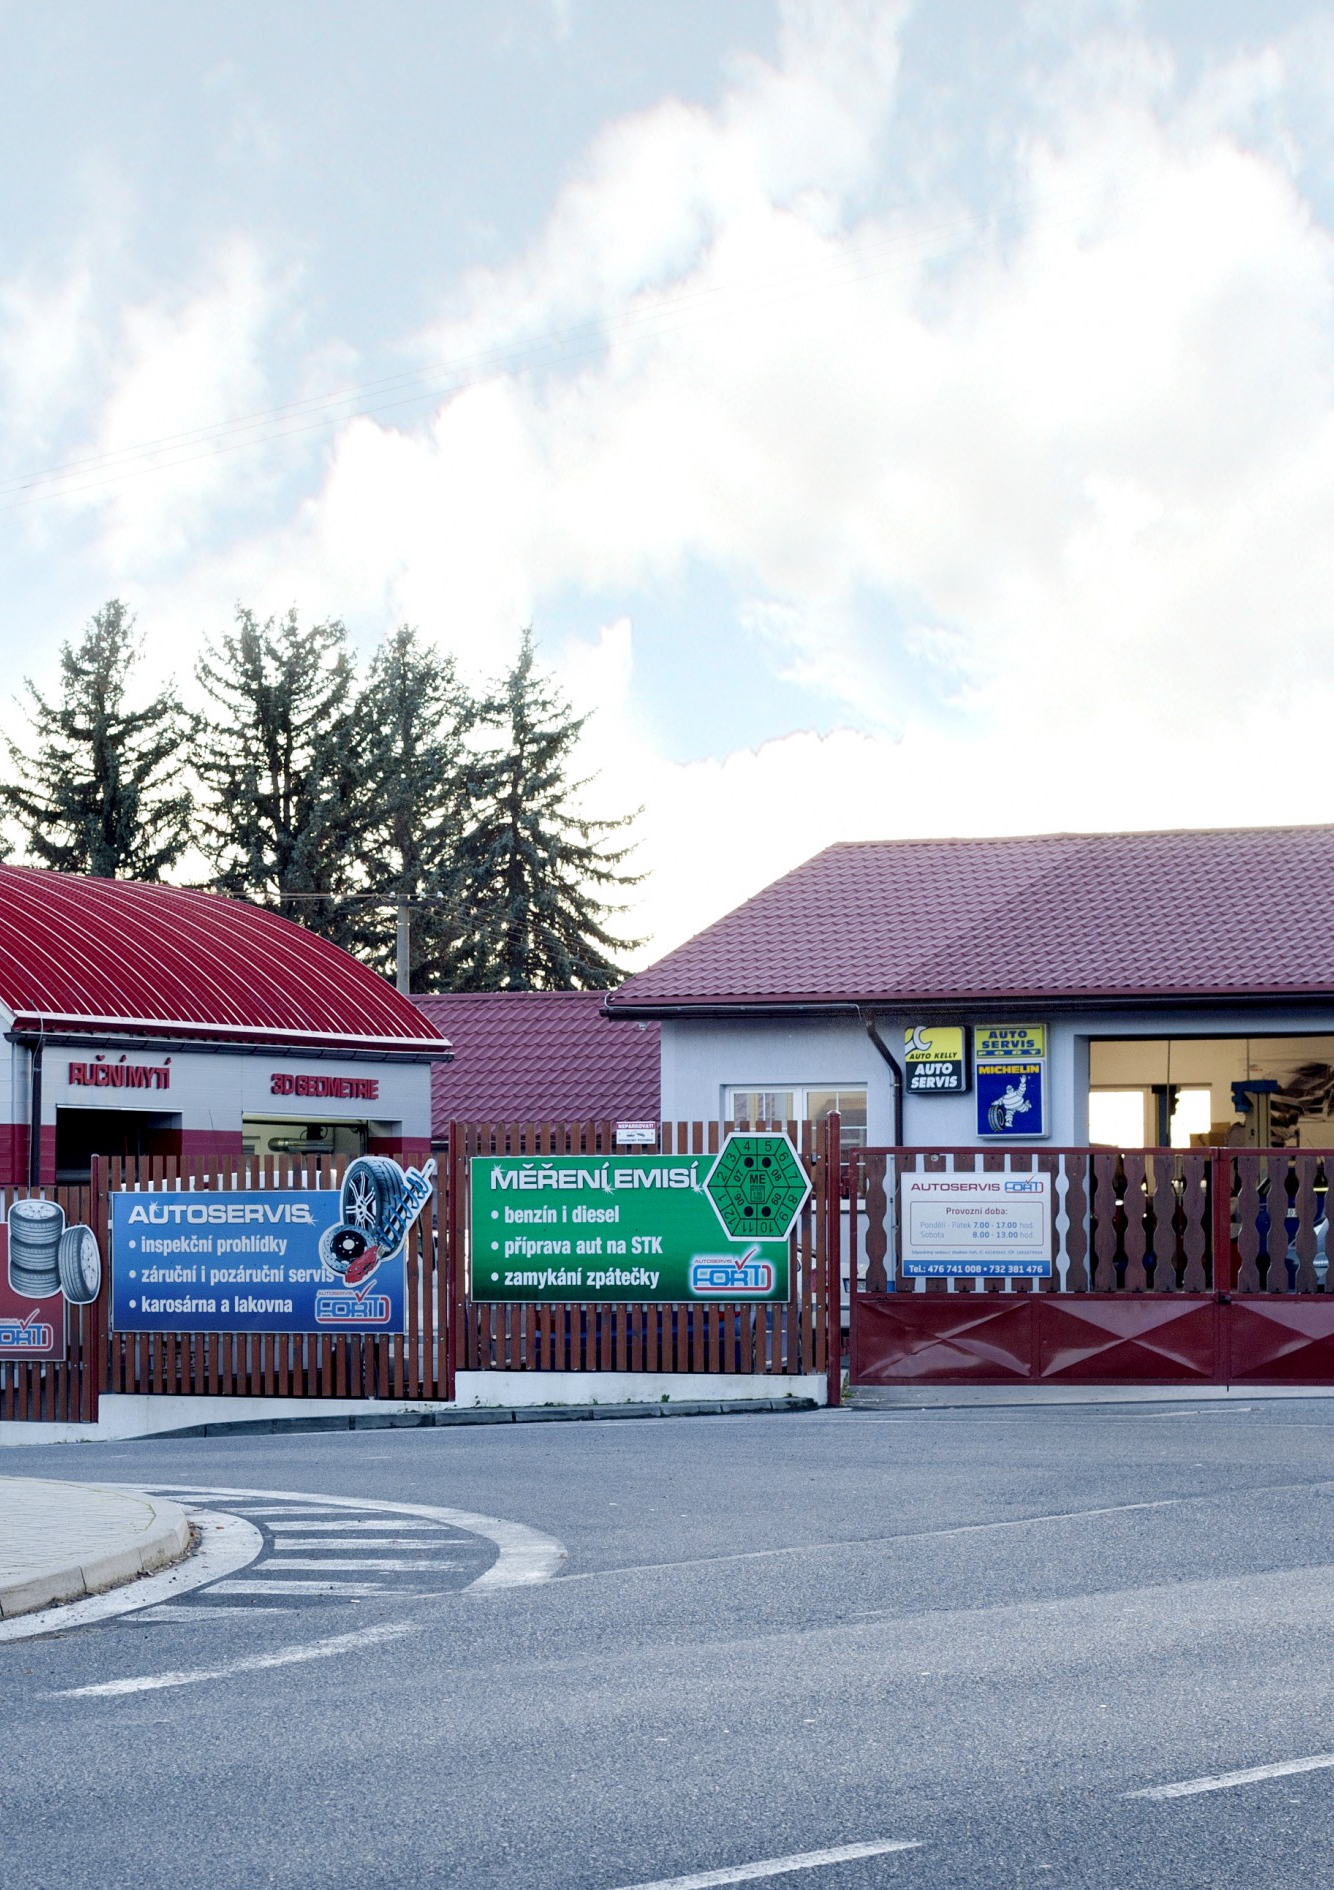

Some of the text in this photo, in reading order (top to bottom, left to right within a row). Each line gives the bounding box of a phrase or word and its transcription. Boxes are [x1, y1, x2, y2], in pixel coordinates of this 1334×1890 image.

[989, 1030, 1027, 1038] AUTO
[982, 1040, 1034, 1048] SERVIS
[69, 1055, 171, 1090] RUČNÍ MYTÍ
[915, 1063, 953, 1075] AUTO
[979, 1065, 1039, 1074] MICHELIN
[271, 1073, 379, 1100] 3D GEOMETRIE
[911, 1076, 957, 1089] SERVIS
[744, 1141, 750, 1151] 4
[765, 1141, 771, 1151] 5
[727, 1152, 736, 1162] 3
[491, 1161, 699, 1191] MĚŘENÍ EMISÍ
[717, 1172, 726, 1182] 2
[733, 1170, 744, 1182] 07
[749, 1174, 765, 1184] ME
[771, 1169, 782, 1181] 08
[789, 1172, 798, 1180] 7
[911, 1182, 1041, 1193] AUTOSERVIS FORT
[771, 1193, 782, 1205] 09
[788, 1194, 797, 1204] 8
[128, 1204, 311, 1224] AUTOSERVIS
[505, 1206, 619, 1223] benzín i diesel
[724, 1209, 736, 1225] 12
[946, 1207, 1008, 1215] Provozní doba:
[742, 1222, 753, 1232] 11
[761, 1222, 773, 1233] 10
[920, 1231, 944, 1239] Sobota
[141, 1235, 287, 1255] inspekční prohlídky
[505, 1237, 663, 1258] příprava aut na STK
[909, 1265, 926, 1273] Tel.:
[928, 1265, 944, 1273] 476
[947, 1265, 962, 1273] 741
[965, 1265, 981, 1273] 008
[989, 1265, 1005, 1273] 732
[1026, 1265, 1043, 1273] 476
[141, 1266, 334, 1286] záruční i pozáruční servis
[505, 1269, 660, 1293] zamykání zpátečky
[693, 1265, 767, 1288] FORT
[141, 1296, 292, 1313] karosárna a lakovna
[317, 1297, 385, 1320] FORT
